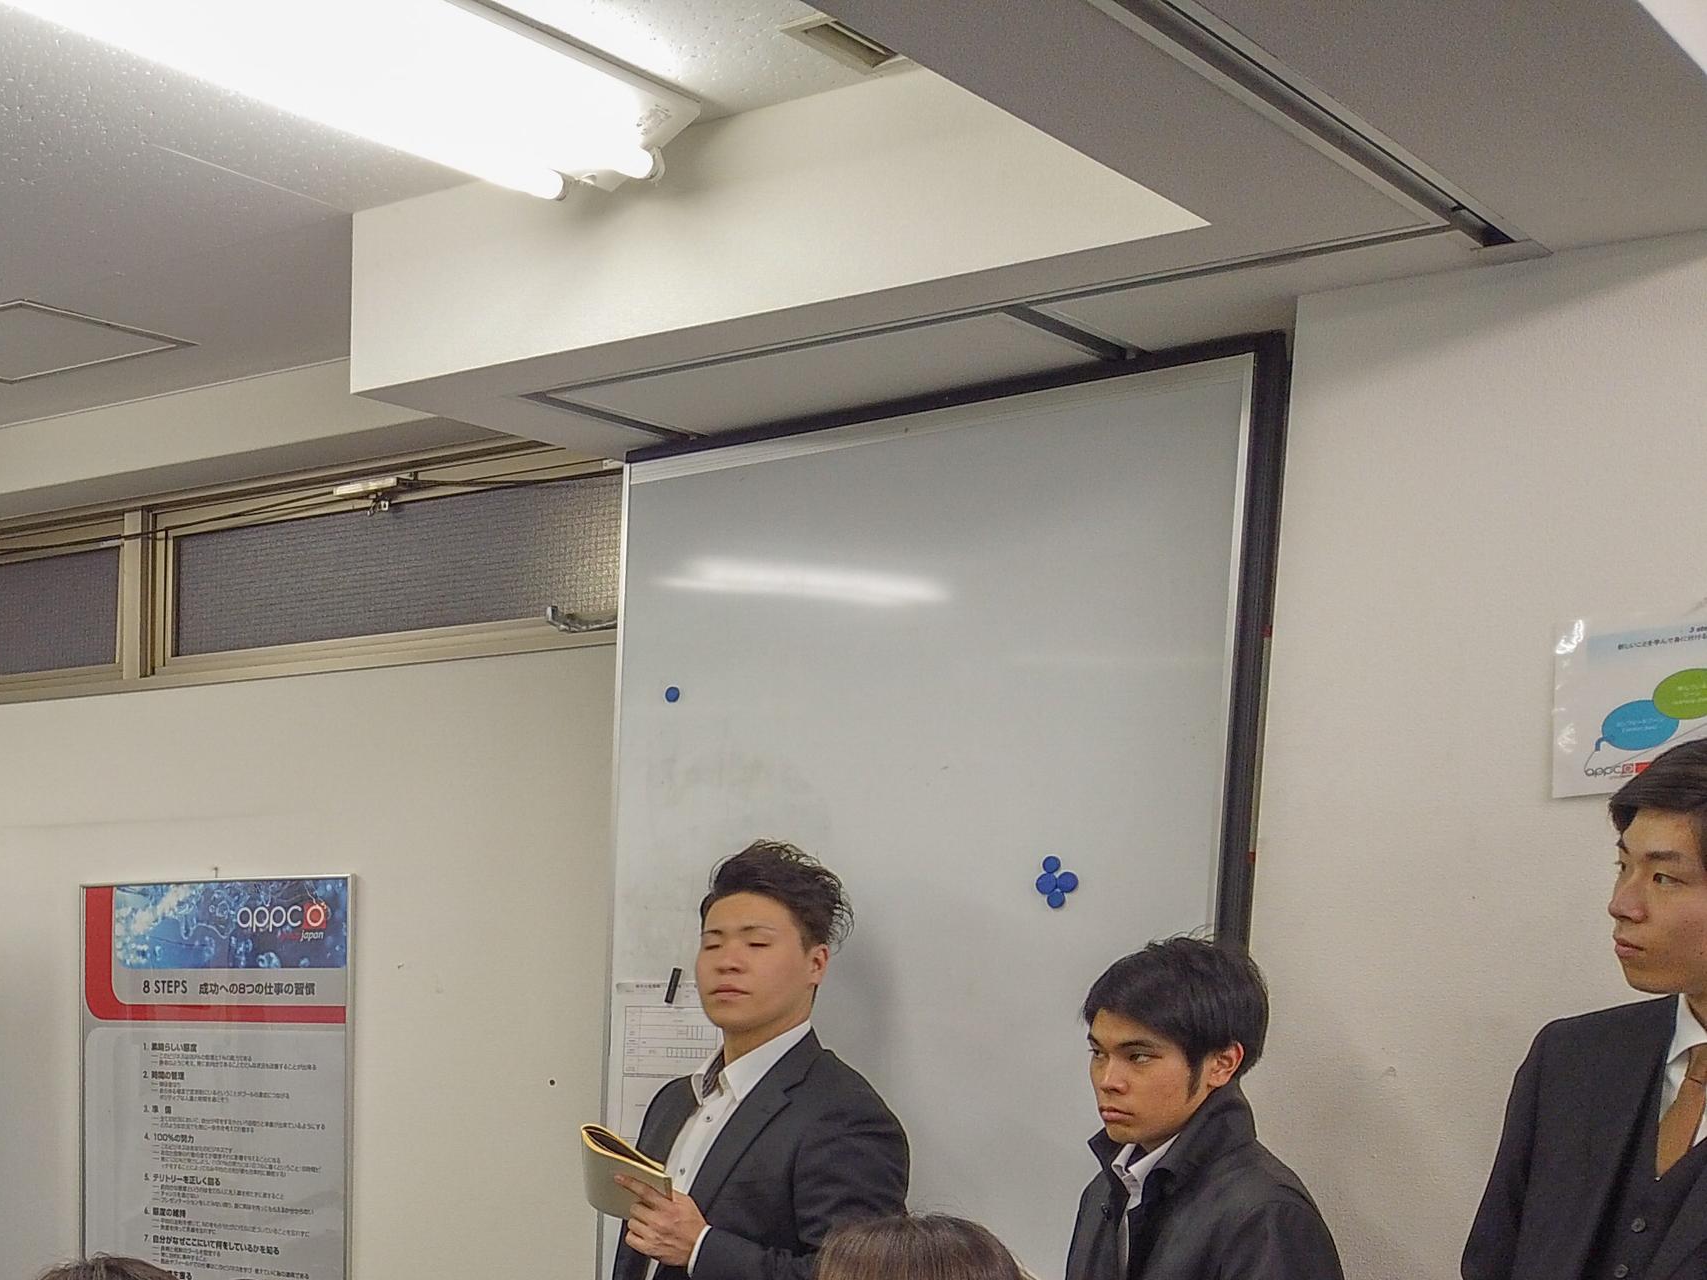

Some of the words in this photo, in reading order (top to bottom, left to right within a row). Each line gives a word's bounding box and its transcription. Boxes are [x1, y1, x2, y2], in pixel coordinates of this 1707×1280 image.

[237, 904, 325, 932] appco
[300, 930, 324, 942] japan
[143, 980, 150, 994] 8
[154, 980, 188, 994] STEPS
[198, 983, 315, 996] 成功への8つの仕事の習慣
